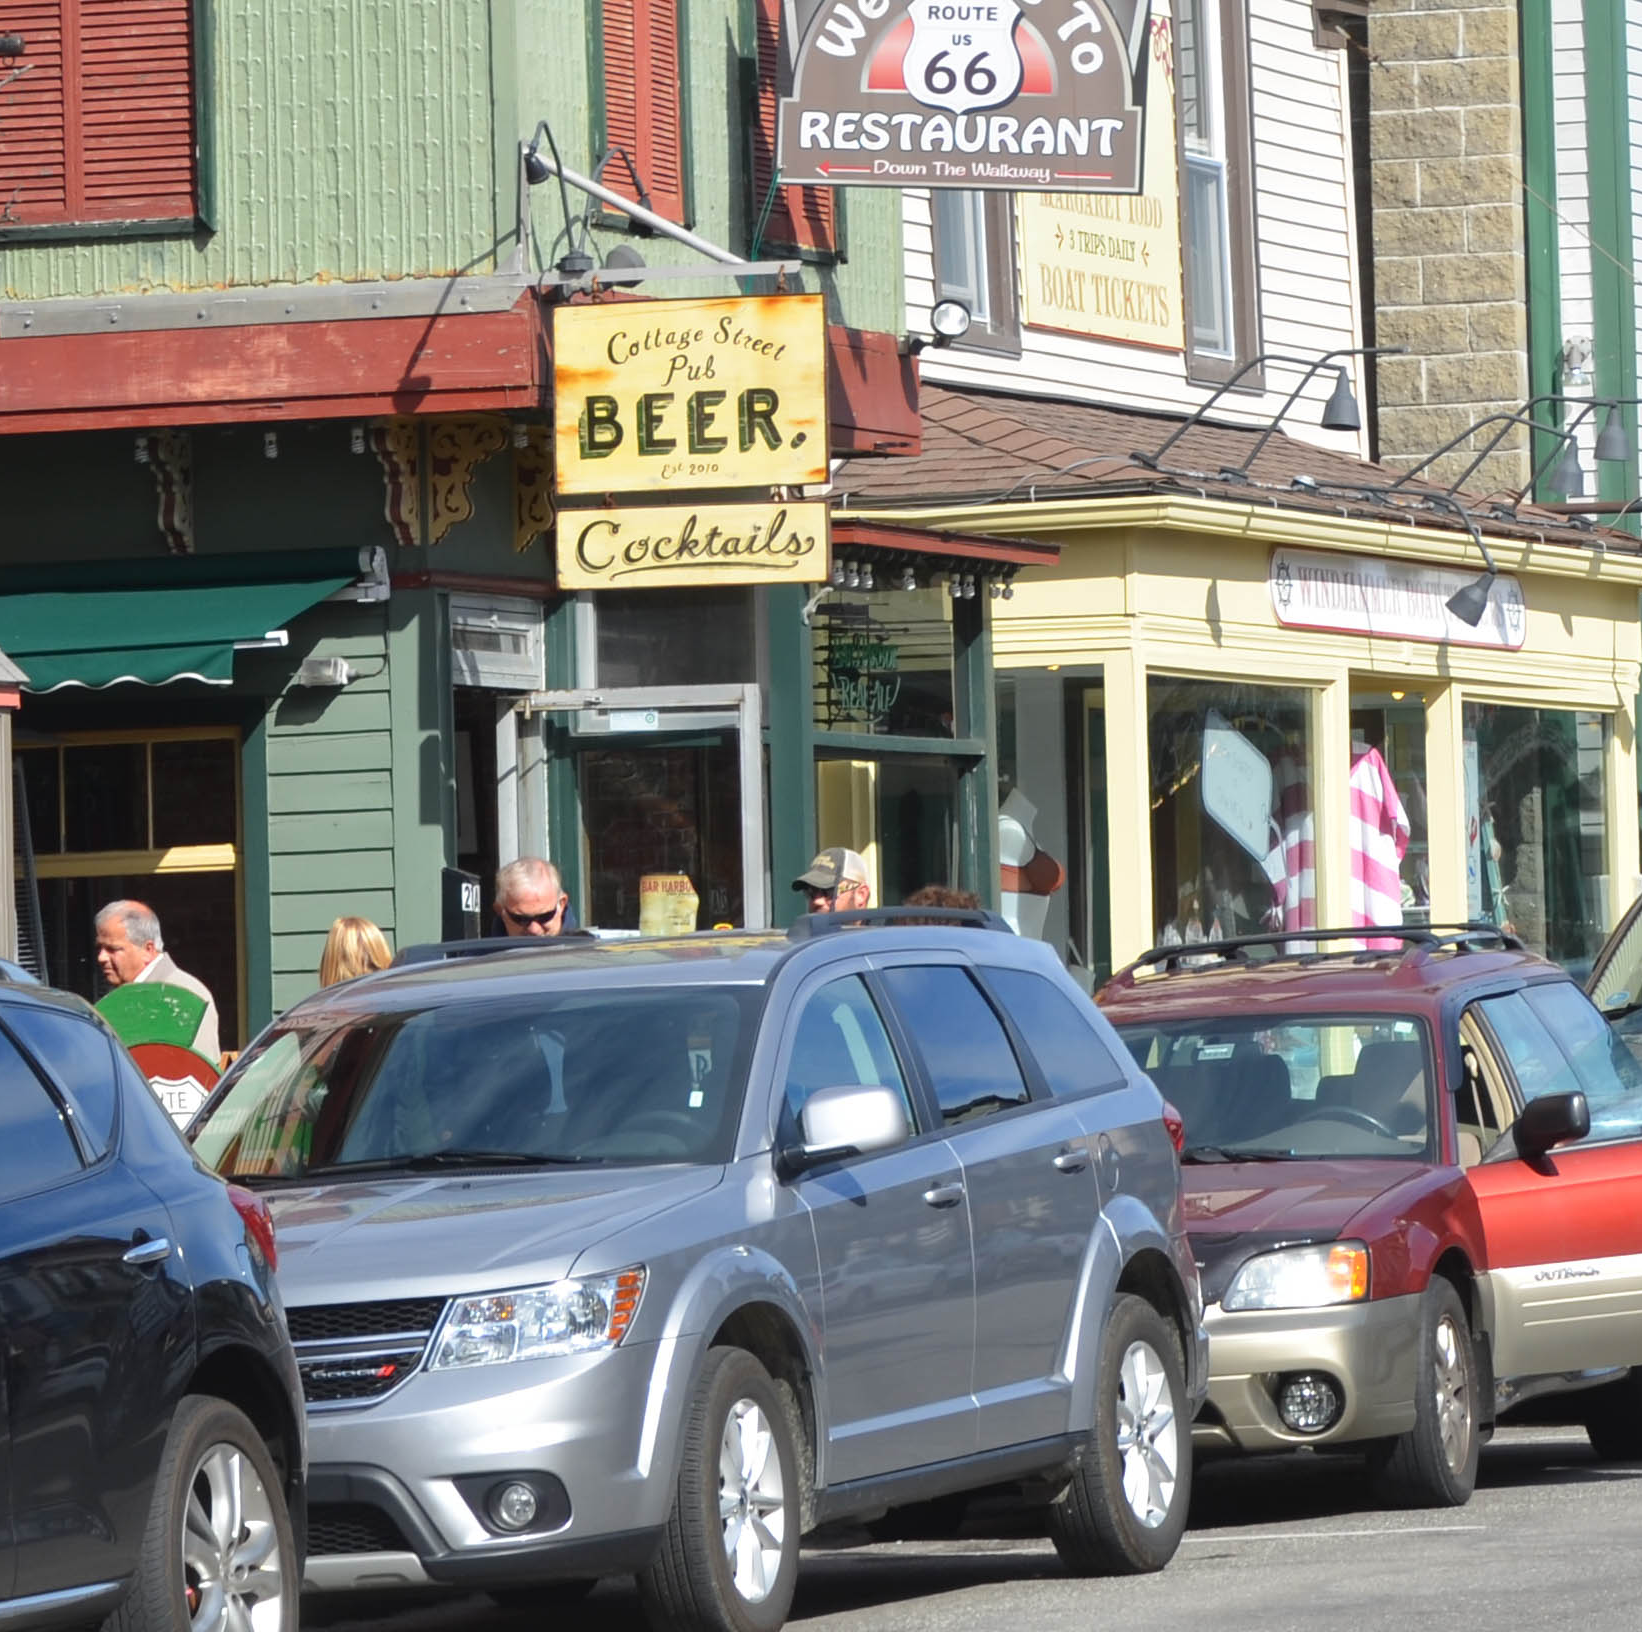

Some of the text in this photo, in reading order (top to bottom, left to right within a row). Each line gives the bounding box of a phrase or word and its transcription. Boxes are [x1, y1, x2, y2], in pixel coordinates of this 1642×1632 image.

[927, 5, 999, 22] ROUTE
[951, 34, 973, 47] US
[1057, 0, 1105, 75] To
[924, 50, 998, 96] 66
[799, 110, 1125, 158] RESTAURANT
[873, 159, 1051, 184] Down The Walkway
[1038, 191, 1163, 230] MARGARET TODD
[1069, 229, 1136, 263] 3 TRIPS DAILY
[1038, 262, 1170, 328] BOAT TICKETS
[606, 316, 787, 365] Cottage Street
[660, 354, 716, 387] Pub
[688, 463, 719, 476] 2010
[575, 508, 816, 574] Cocktails
